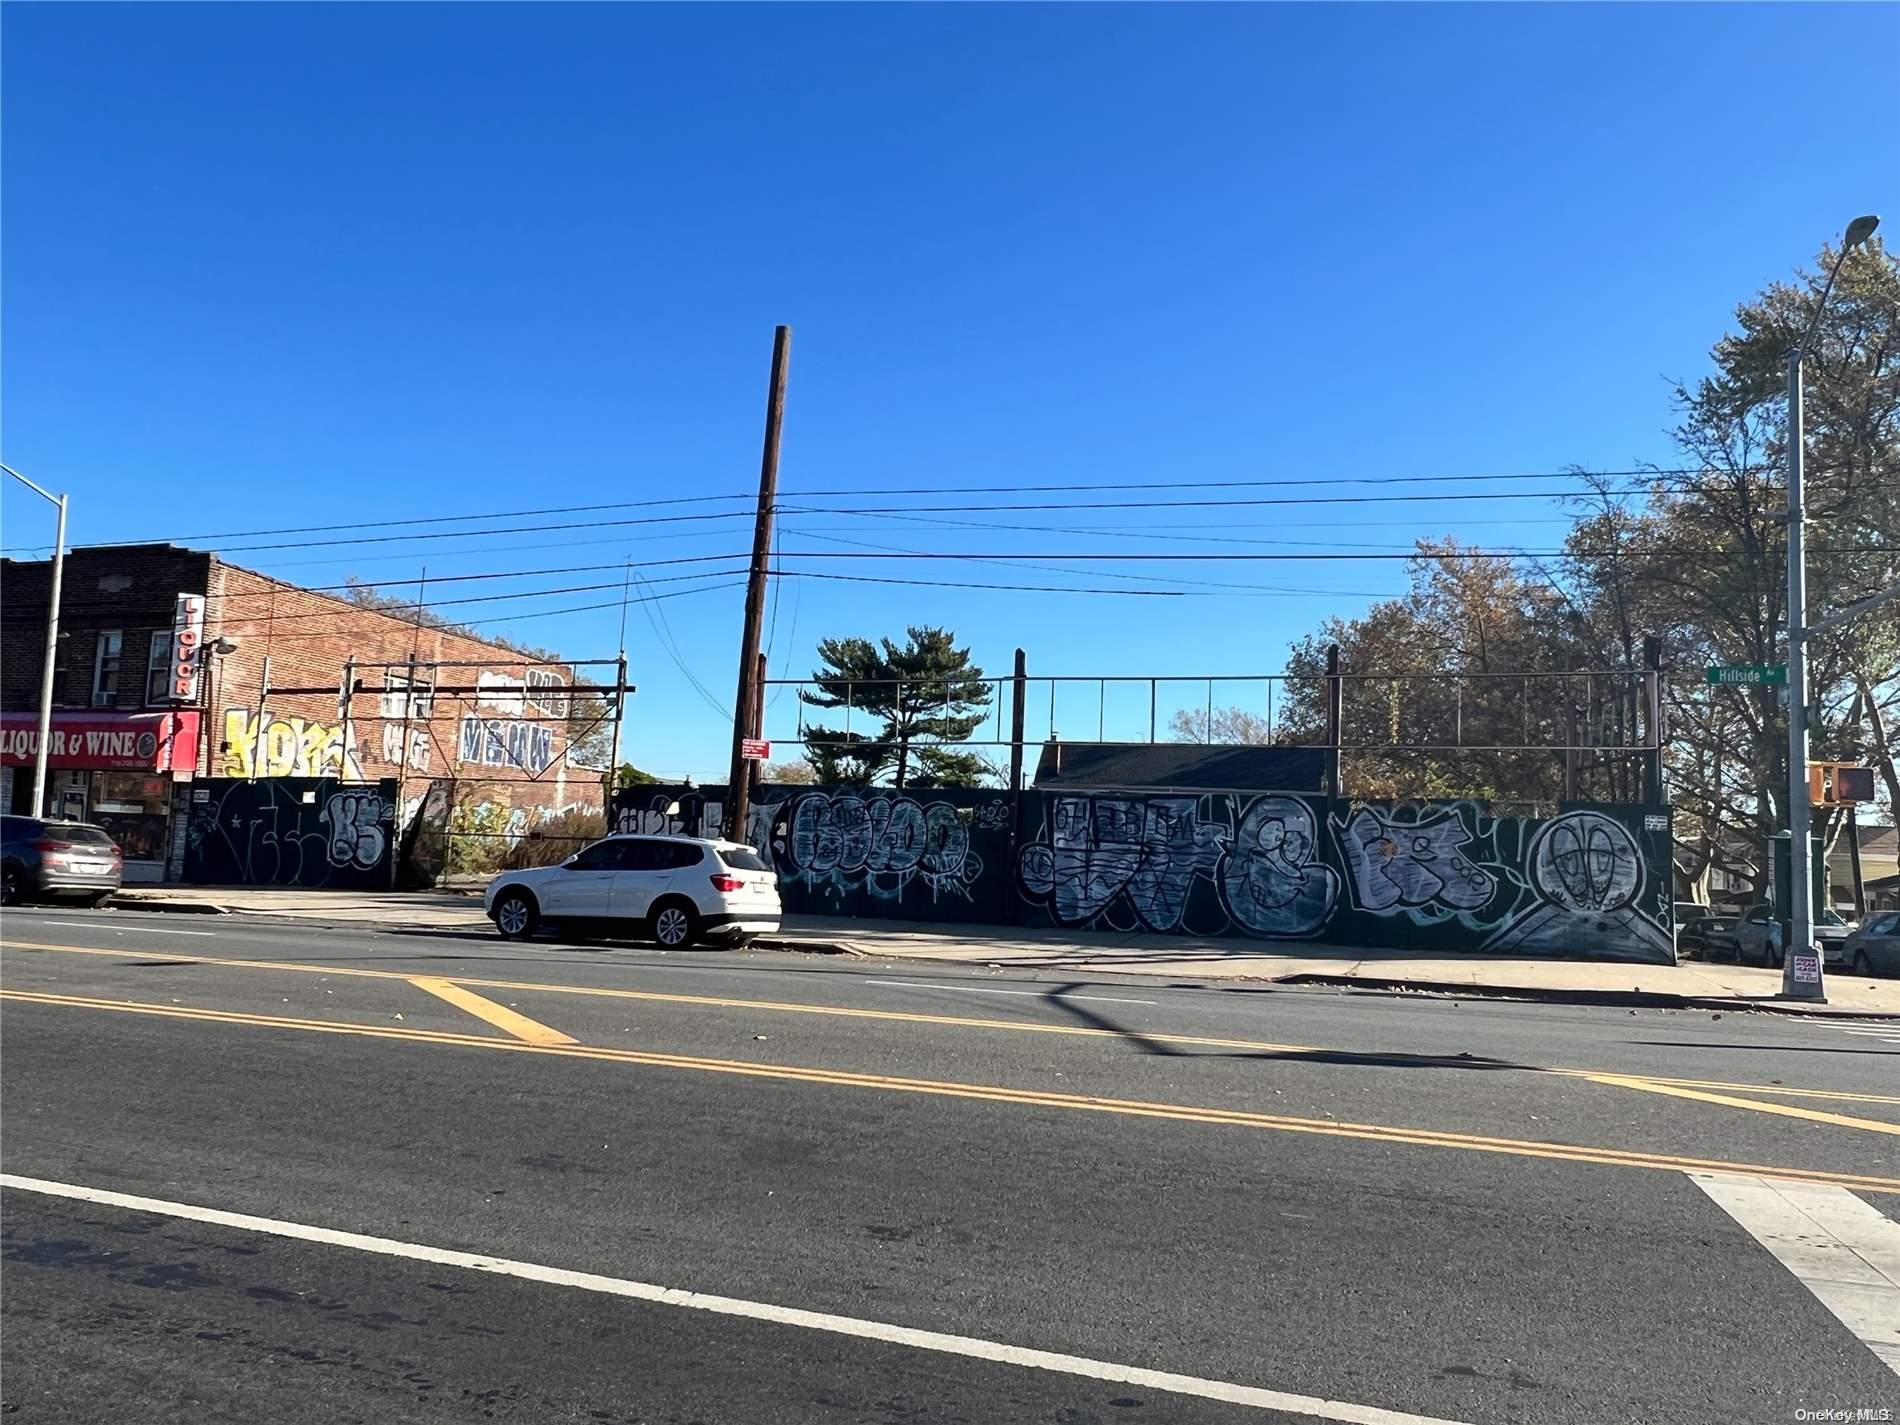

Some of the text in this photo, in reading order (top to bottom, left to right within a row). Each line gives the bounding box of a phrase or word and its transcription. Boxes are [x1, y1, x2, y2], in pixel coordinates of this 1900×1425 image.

[176, 598, 197, 695] LIQUOR
[1720, 669, 1760, 682] Hillside
[69, 734, 83, 756] &
[86, 731, 136, 756] WINE
